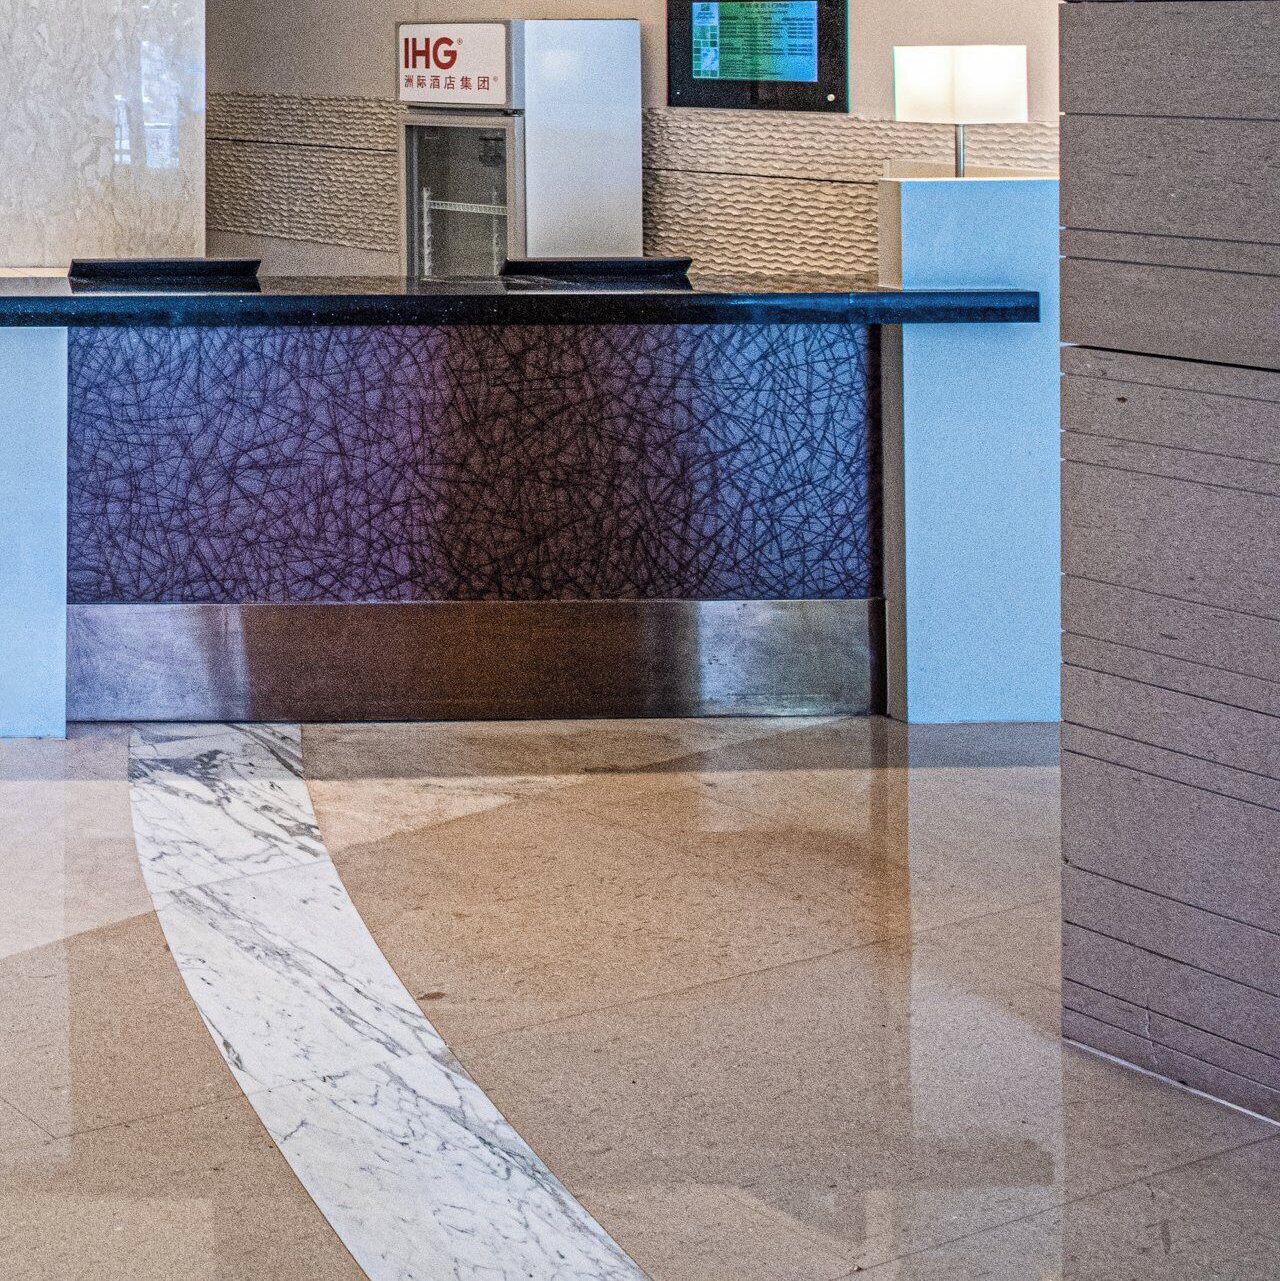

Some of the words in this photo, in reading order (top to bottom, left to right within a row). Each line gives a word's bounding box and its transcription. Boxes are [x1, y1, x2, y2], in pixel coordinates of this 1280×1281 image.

[404, 37, 457, 70] IHG
[404, 75, 490, 90] 洲际酒店集团
